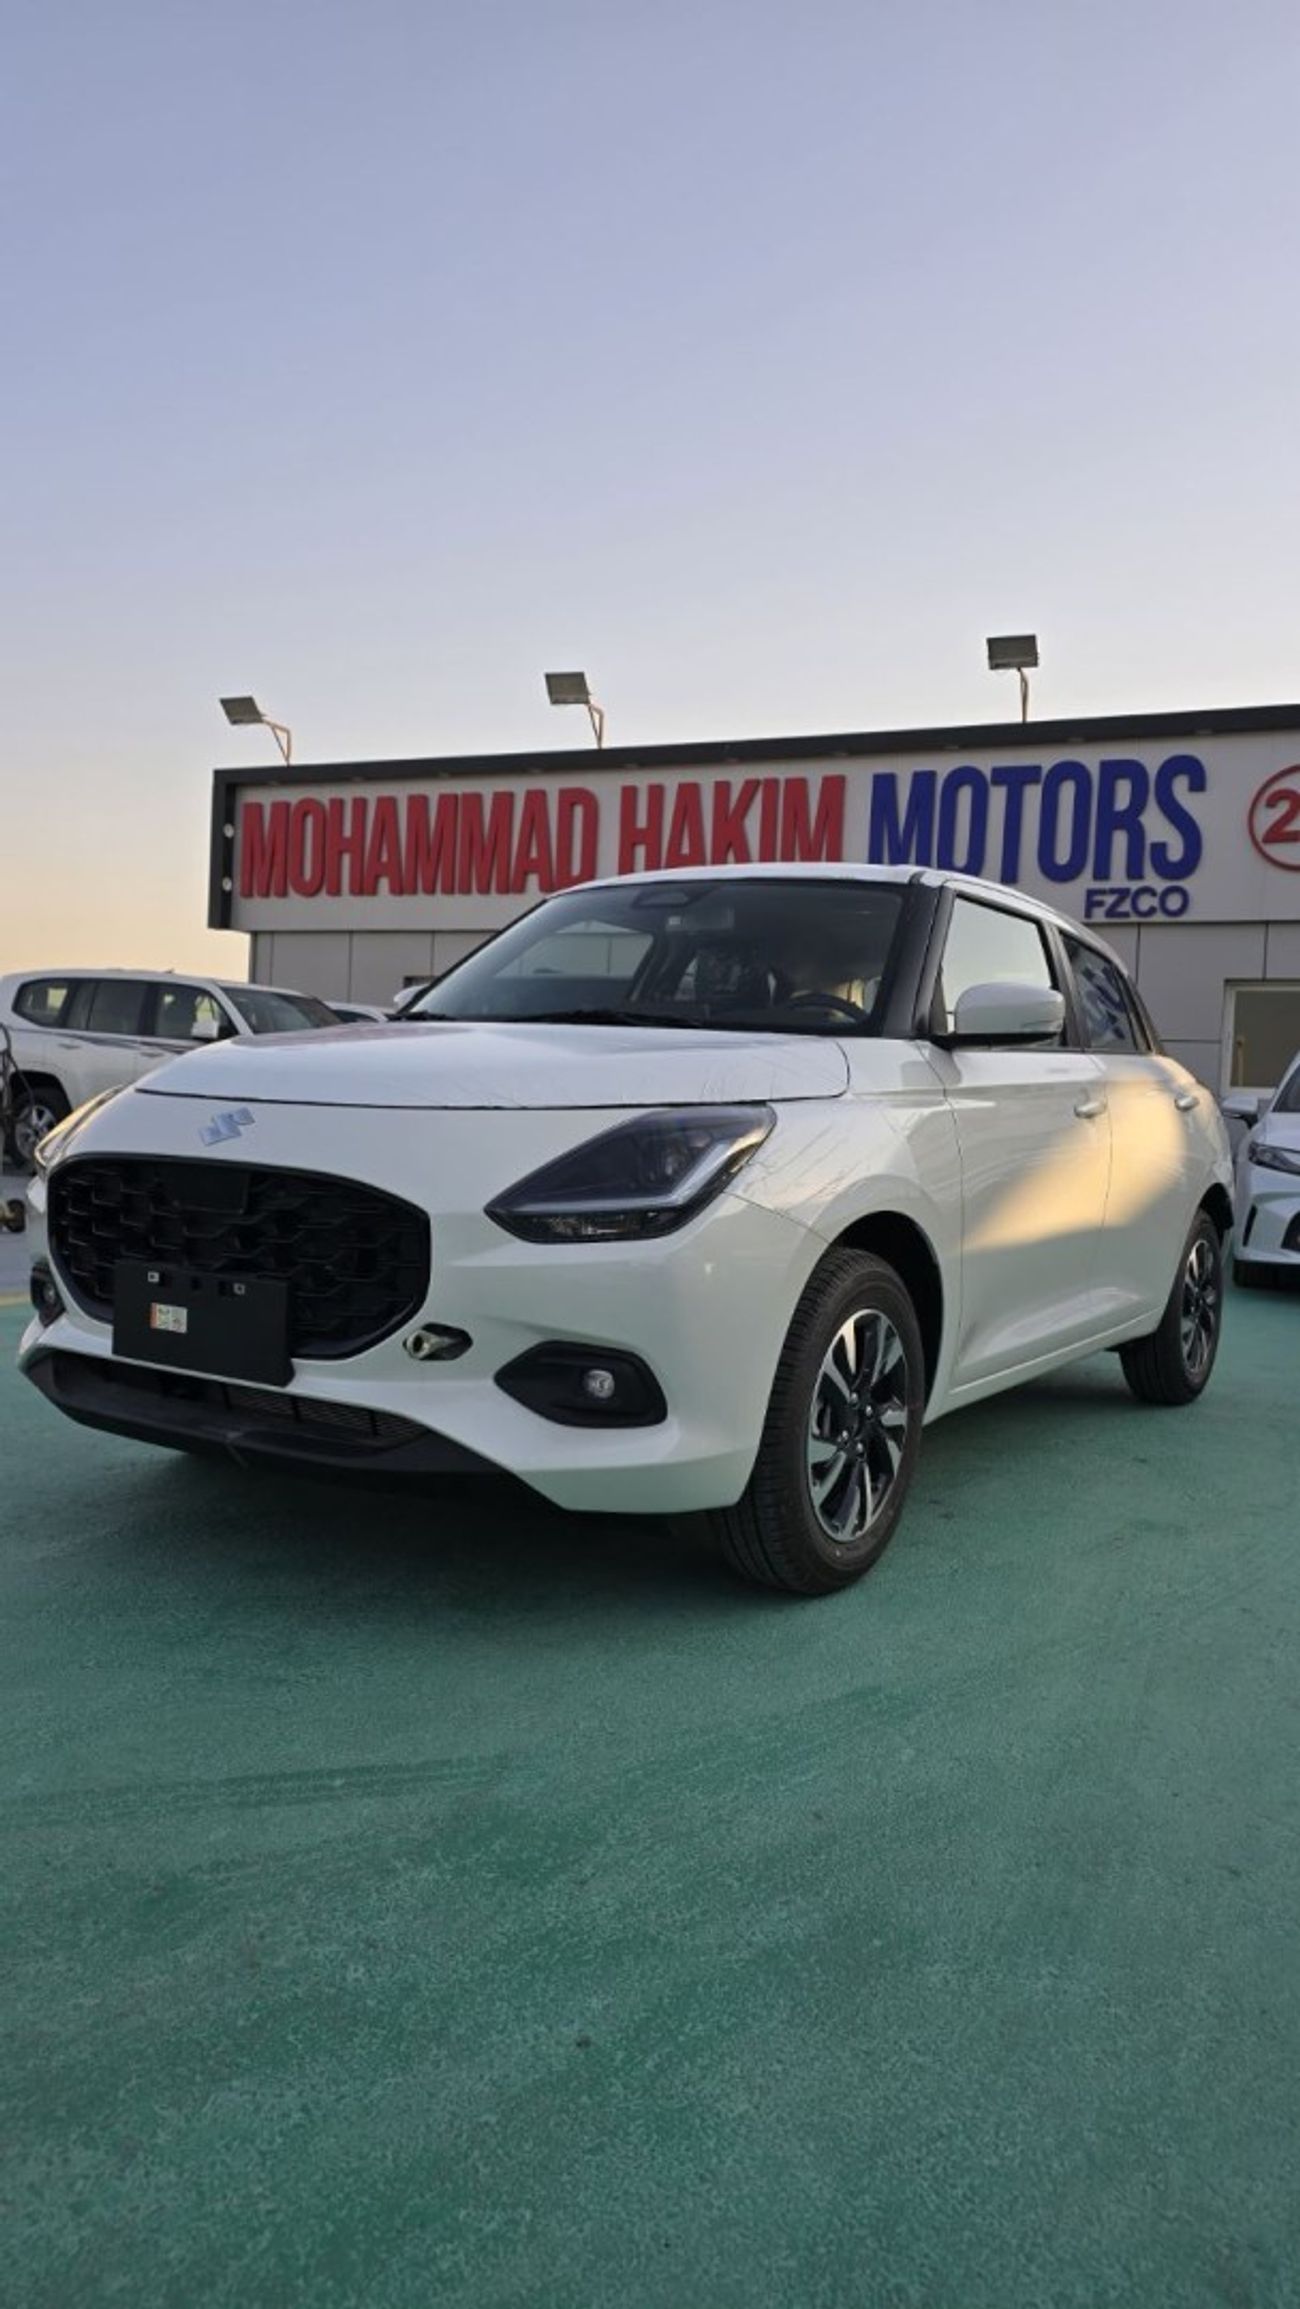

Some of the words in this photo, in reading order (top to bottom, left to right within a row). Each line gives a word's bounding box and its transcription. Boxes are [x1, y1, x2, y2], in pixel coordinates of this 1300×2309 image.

[240, 788, 599, 898] MOHAMMAD
[618, 775, 846, 873] HAKIM
[868, 755, 1207, 884] MOTORS
[1084, 885, 1190, 919] FZCO
